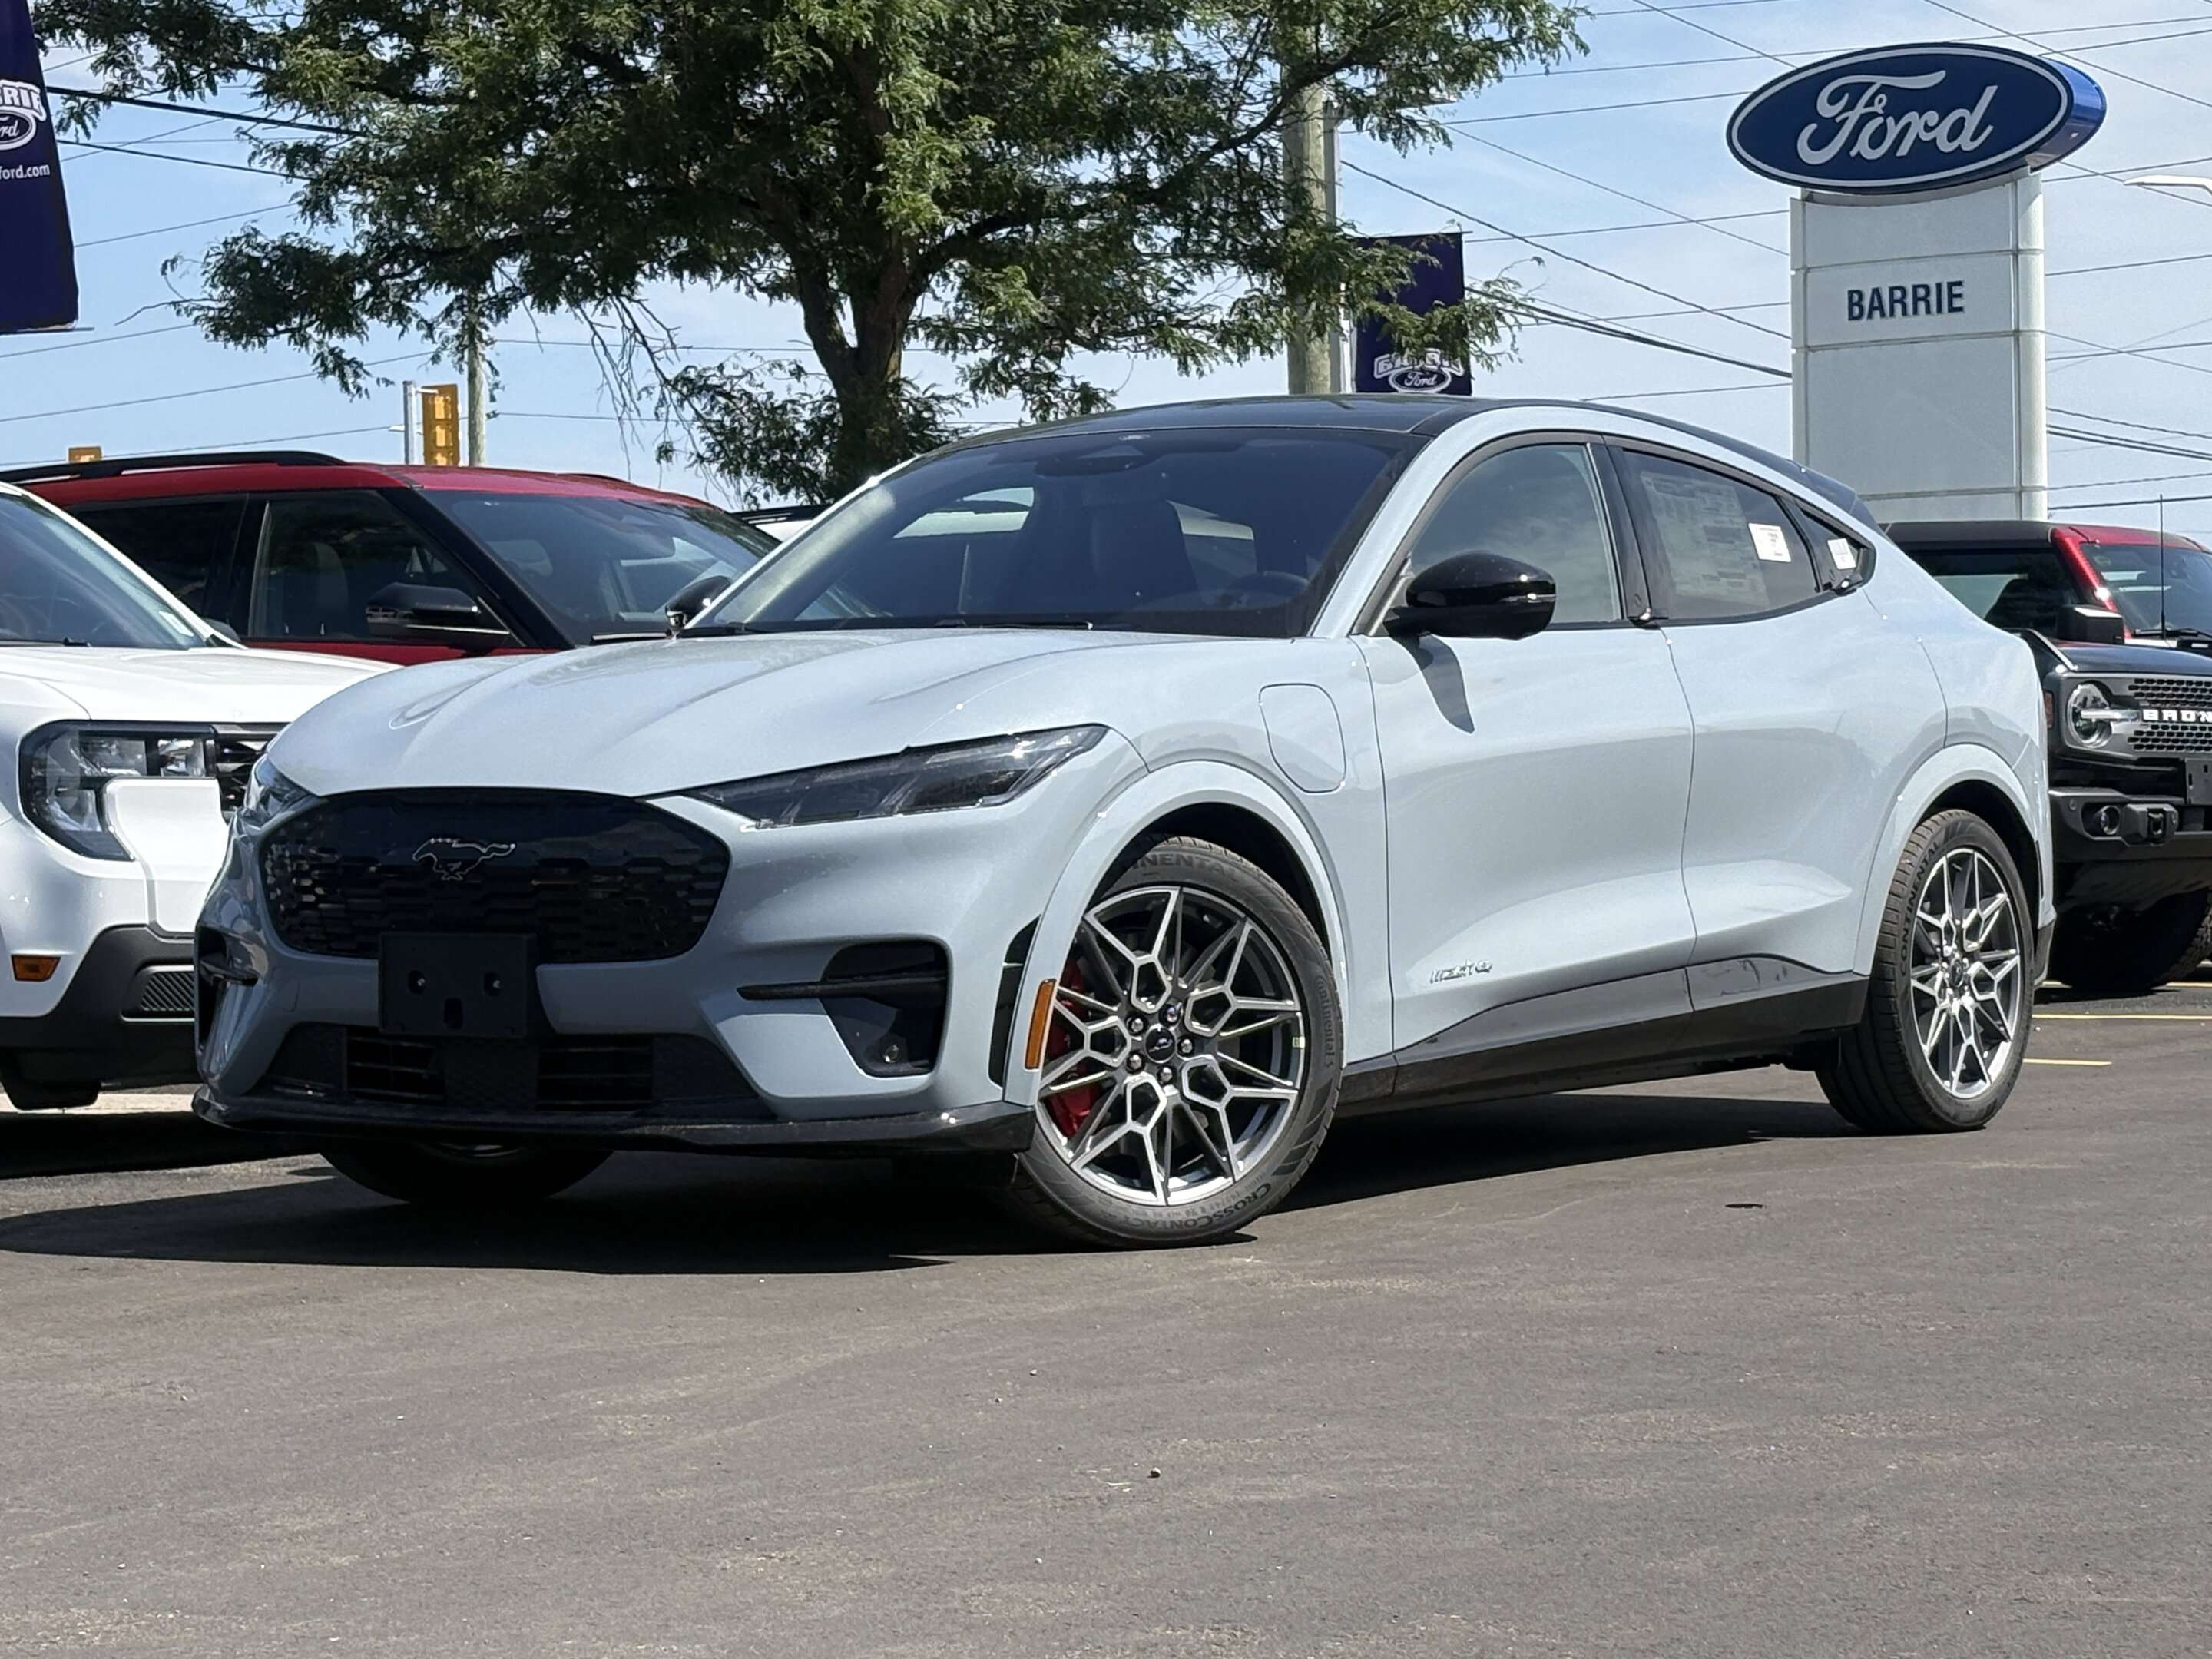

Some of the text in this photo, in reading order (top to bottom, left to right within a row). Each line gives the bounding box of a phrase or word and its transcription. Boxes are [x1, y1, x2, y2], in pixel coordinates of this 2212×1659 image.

[1796, 69, 1998, 165] Ford
[1846, 280, 1965, 322] BARRIE
[1403, 371, 1438, 386] Ford
